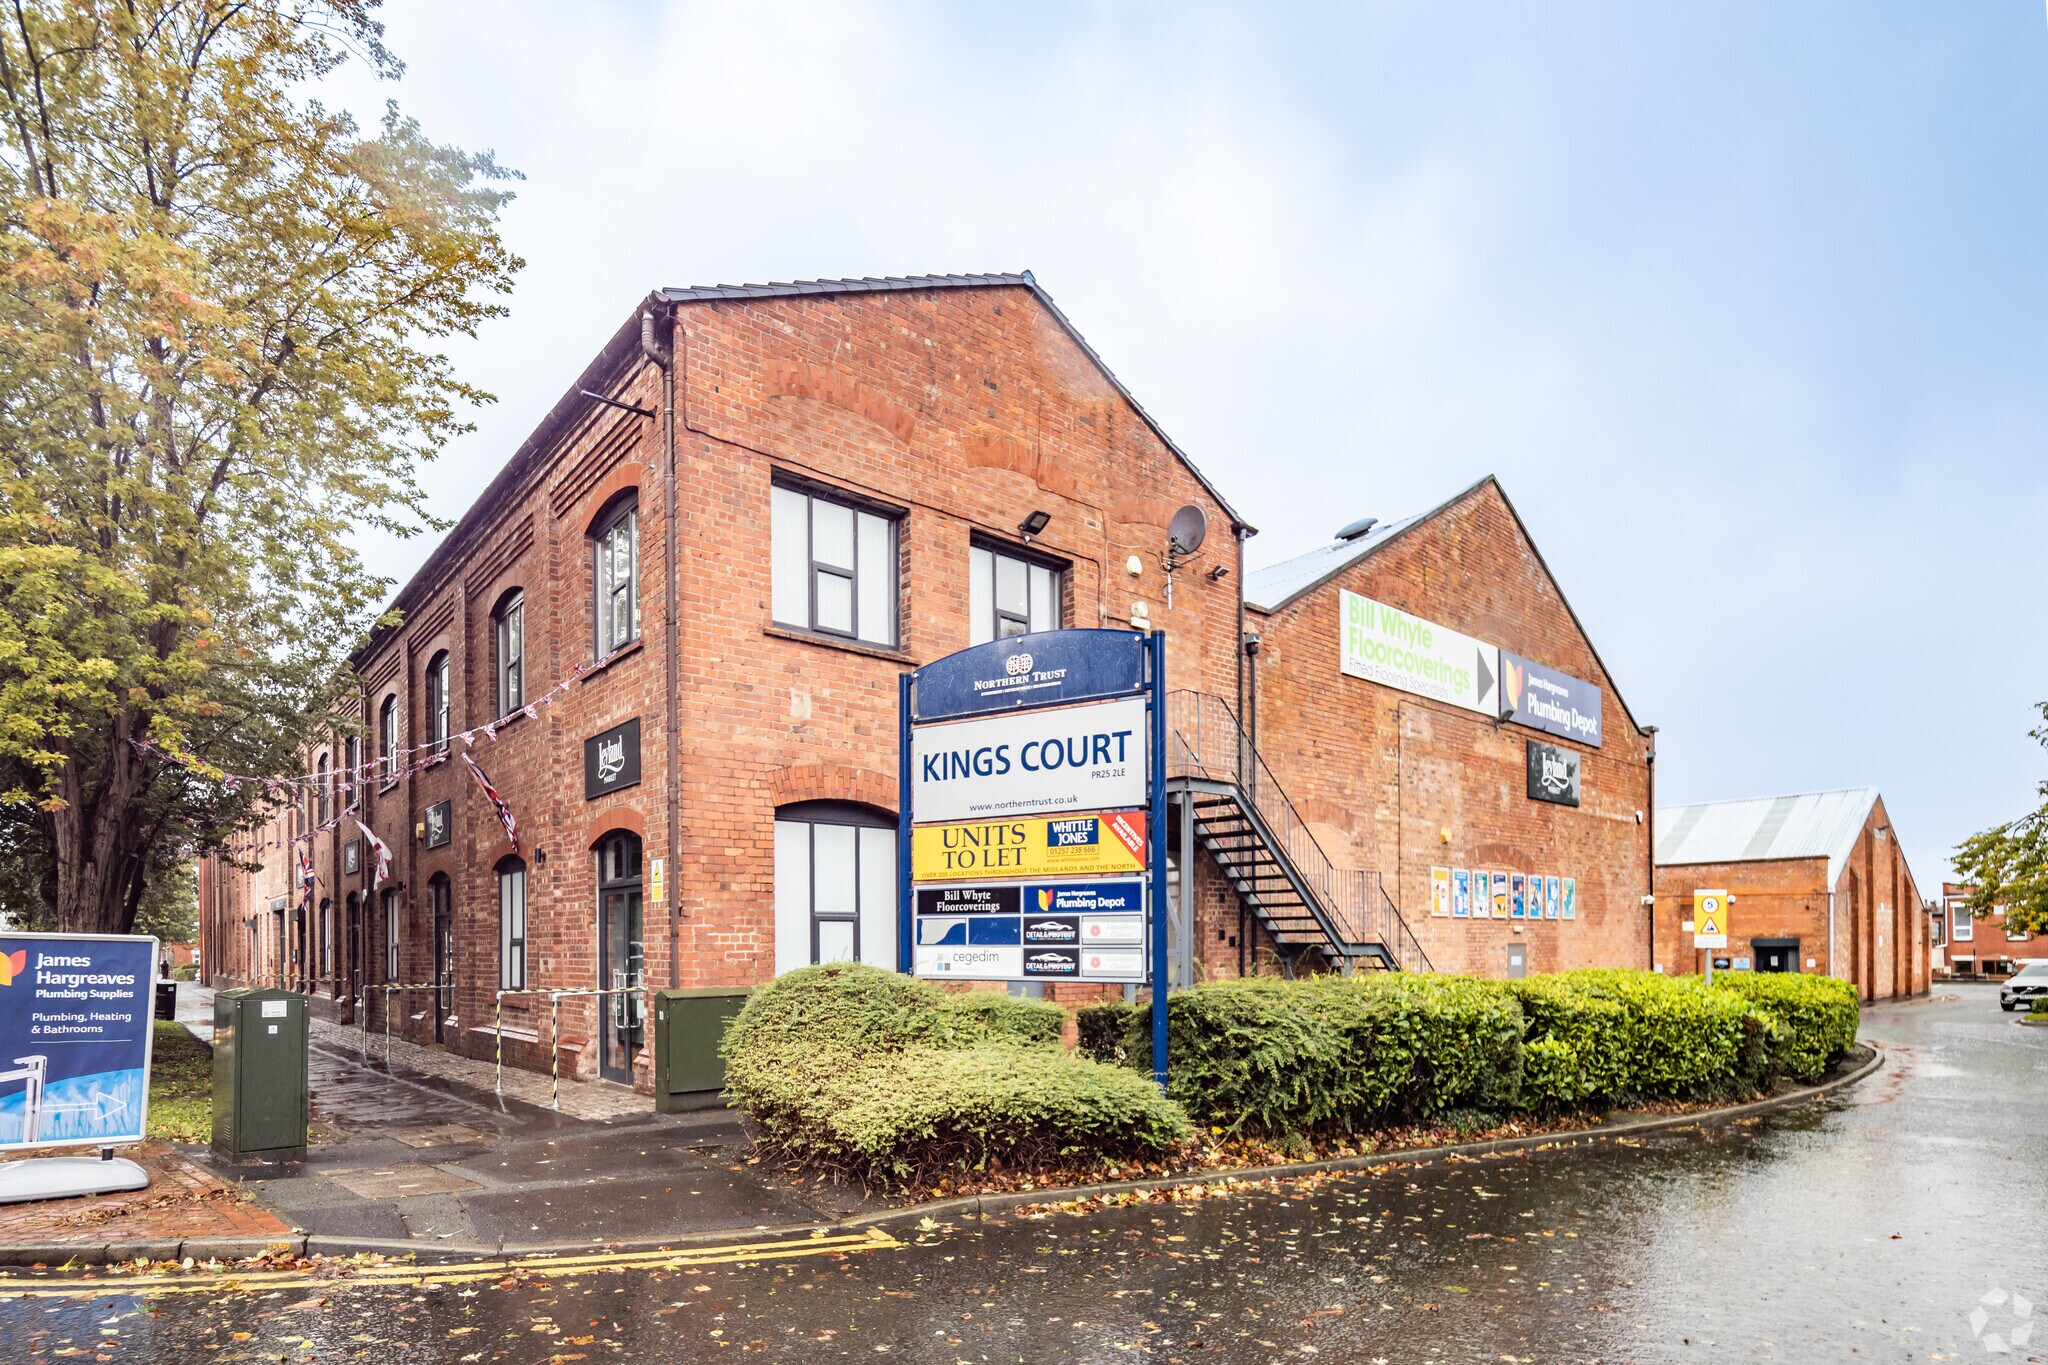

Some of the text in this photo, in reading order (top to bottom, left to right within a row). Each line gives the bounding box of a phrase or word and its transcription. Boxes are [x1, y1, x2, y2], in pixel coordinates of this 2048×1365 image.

[1349, 594, 1432, 650] Bill Whyte
[1349, 629, 1470, 695] Floorcoverings
[974, 675, 1030, 690] NORTHERN
[1032, 669, 1067, 682] TRUST
[1349, 657, 1449, 699] Fitted Flooring Specialists
[1528, 673, 1568, 698] James Hargreaves
[1528, 692, 1598, 736] Plumbing Depot
[923, 730, 1132, 782] KINGS COURT
[1092, 768, 1126, 779] PR25 2LE
[970, 794, 1078, 812] www.northerntrust.co.uk
[1052, 820, 1093, 833] WHITTLE
[1116, 815, 1144, 846] INCENTIVES
[942, 824, 1026, 848] UNITS
[1058, 832, 1088, 846] JONES
[1112, 822, 1140, 852] AVAILABLE
[942, 847, 1026, 869] TO LET
[944, 890, 991, 902] Bill Whyte
[1056, 897, 1125, 909] Plumbing Depot
[1707, 901, 1713, 909] 5
[936, 901, 1000, 913] Floorcoverings
[35, 952, 90, 970] James
[953, 950, 999, 965] cegedim
[36, 971, 134, 988] Hargreaves
[36, 989, 134, 1000] Plumbing Supplies
[32, 1012, 132, 1023] Plumbing, Heating
[31, 1025, 103, 1034] & Bathrooms
